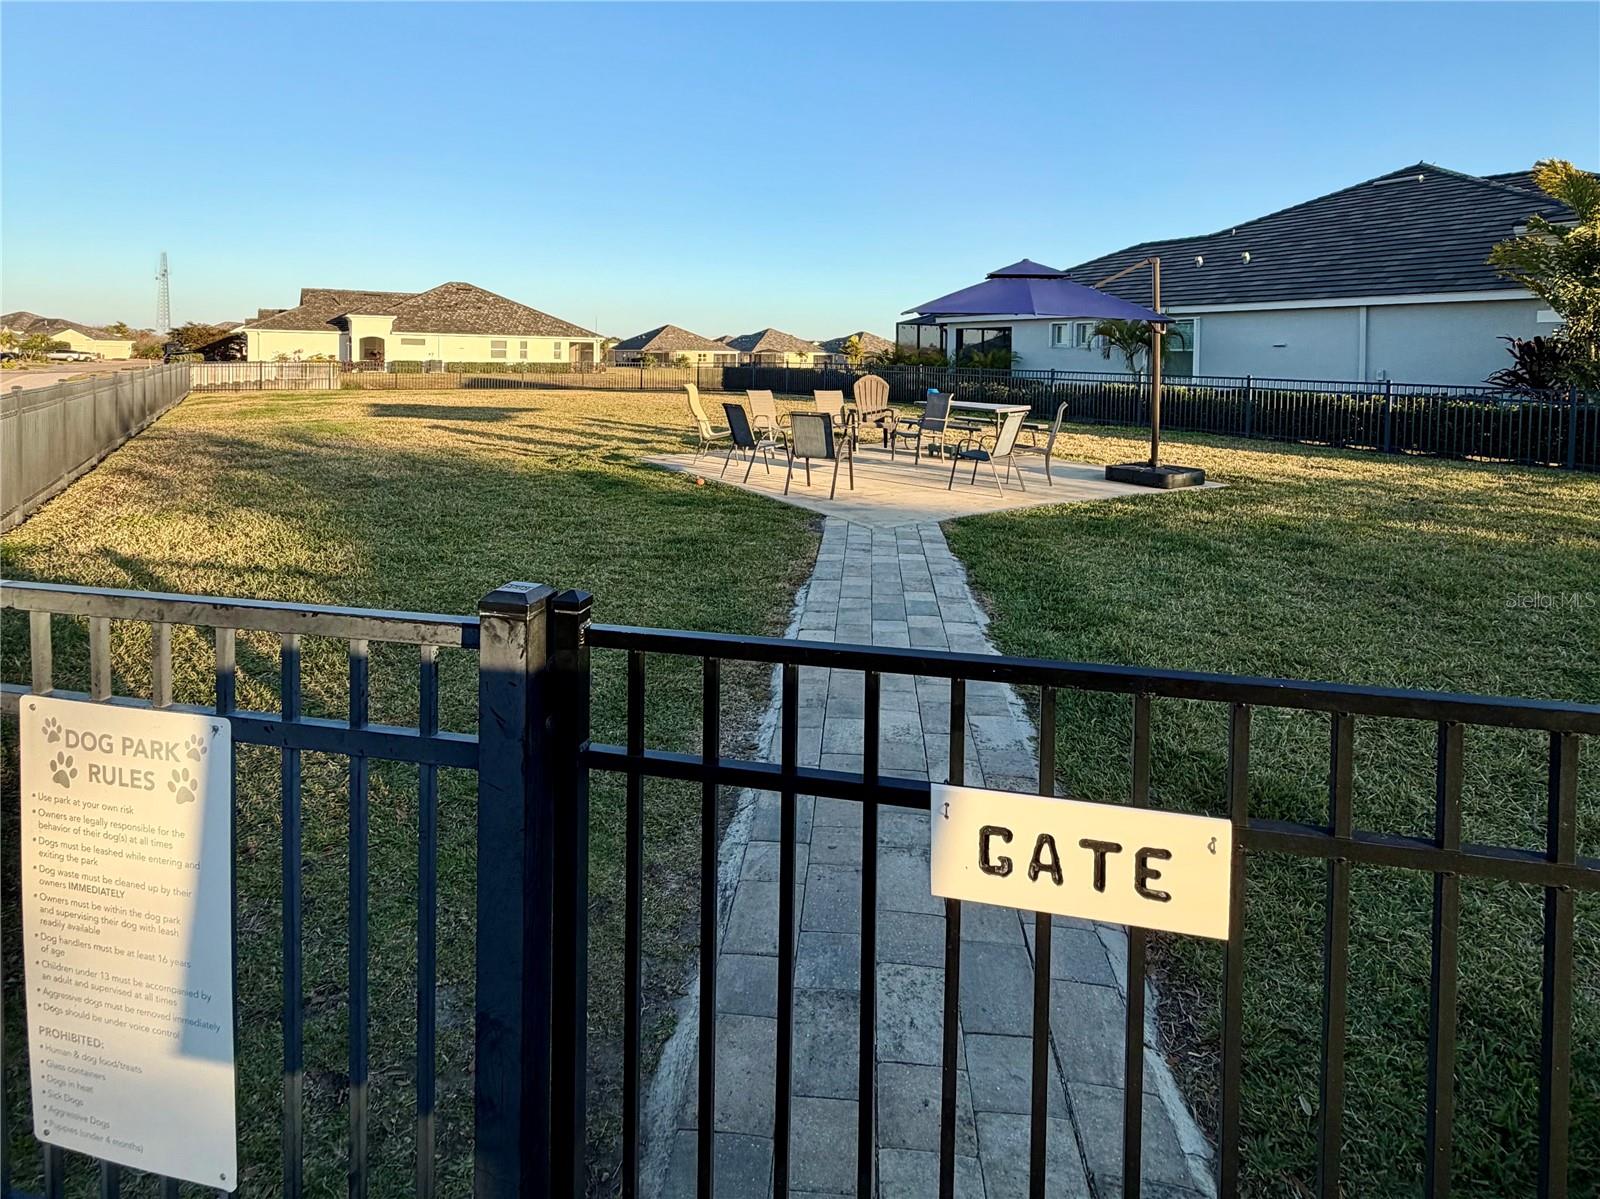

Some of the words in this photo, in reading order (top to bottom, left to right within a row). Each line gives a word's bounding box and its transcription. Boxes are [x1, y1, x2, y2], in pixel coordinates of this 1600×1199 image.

[65, 729, 114, 754] DOG
[121, 737, 180, 762] PARK
[88, 764, 155, 791] RULES
[38, 793, 52, 803] Use
[54, 795, 70, 807] park
[73, 798, 80, 807] at
[82, 800, 99, 810] your
[102, 804, 117, 812] own
[121, 805, 134, 815] risk
[38, 809, 67, 822] Owners
[69, 813, 81, 823] are
[83, 815, 108, 829] legally
[110, 819, 156, 835] responsible
[158, 826, 169, 837] for
[172, 828, 185, 839] the
[39, 820, 70, 833] behavior
[73, 826, 81, 835] of
[83, 827, 100, 838] their
[103, 830, 127, 843] dog(s)
[130, 834, 137, 844] at
[139, 836, 148, 845] all
[151, 838, 172, 849] times
[39, 836, 58, 849] Dogs
[61, 841, 78, 852] must
[81, 843, 91, 853] be
[93, 844, 123, 858] leashed
[126, 850, 145, 861] while
[148, 854, 182, 869] entering
[185, 859, 200, 870] and
[39, 849, 64, 861] exiting
[66, 854, 79, 864] the
[81, 855, 98, 867] park
[979, 825, 1171, 902] GATE
[39, 864, 55, 877] Dog
[58, 870, 79, 880] waste
[82, 872, 100, 883] must
[103, 875, 112, 884] be
[115, 876, 145, 890] cleaned
[148, 883, 158, 894] up
[161, 885, 171, 897] by
[173, 886, 192, 898] their
[39, 879, 66, 889] owners
[69, 882, 124, 899] IMMEDIATELY
[40, 892, 69, 905] Owners
[71, 898, 89, 908] must
[91, 901, 101, 911] be
[104, 902, 127, 915] within
[129, 907, 142, 917] the
[145, 910, 161, 923] dog
[163, 914, 181, 926] park
[40, 905, 54, 915] and
[56, 908, 99, 924] supervising
[101, 915, 118, 926] their
[121, 918, 137, 932] dog
[139, 921, 156, 932] with
[159, 925, 179, 937] leash
[40, 917, 65, 930] readily
[67, 921, 100, 935] available
[40, 932, 57, 946] Dog
[59, 935, 91, 949] handlers
[94, 944, 112, 953] must
[114, 945, 125, 955] be
[127, 949, 135, 957] at
[137, 949, 156, 961] least
[159, 954, 168, 964] 16
[170, 956, 192, 968] years
[41, 945, 49, 953] of
[51, 947, 65, 957] age
[41, 960, 73, 973] Children
[75, 966, 97, 978] under
[101, 970, 109, 981] 13
[112, 973, 130, 985] must
[133, 977, 143, 987] be
[145, 980, 199, 999] accompanied
[201, 991, 212, 1003] by
[53, 974, 72, 985] adult
[74, 979, 88, 989] and
[91, 982, 132, 997] supervised
[135, 990, 142, 999] at
[145, 991, 153, 1001] all
[156, 993, 177, 1006] times
[43, 987, 82, 1004] Aggressive
[84, 994, 102, 1008] dogs
[105, 998, 123, 1010] must
[125, 1002, 135, 1013] be
[136, 1005, 171, 1021] removed
[172, 1012, 220, 1033] immediately
[43, 1002, 63, 1015] Dogs
[66, 1007, 90, 1020] should
[92, 1012, 102, 1022] be
[104, 1016, 127, 1028] under
[129, 1021, 150, 1033] voice
[152, 1025, 180, 1038] control
[39, 1025, 104, 1049] PROHIBITED:
[90, 1115, 110, 1129] Dogs
